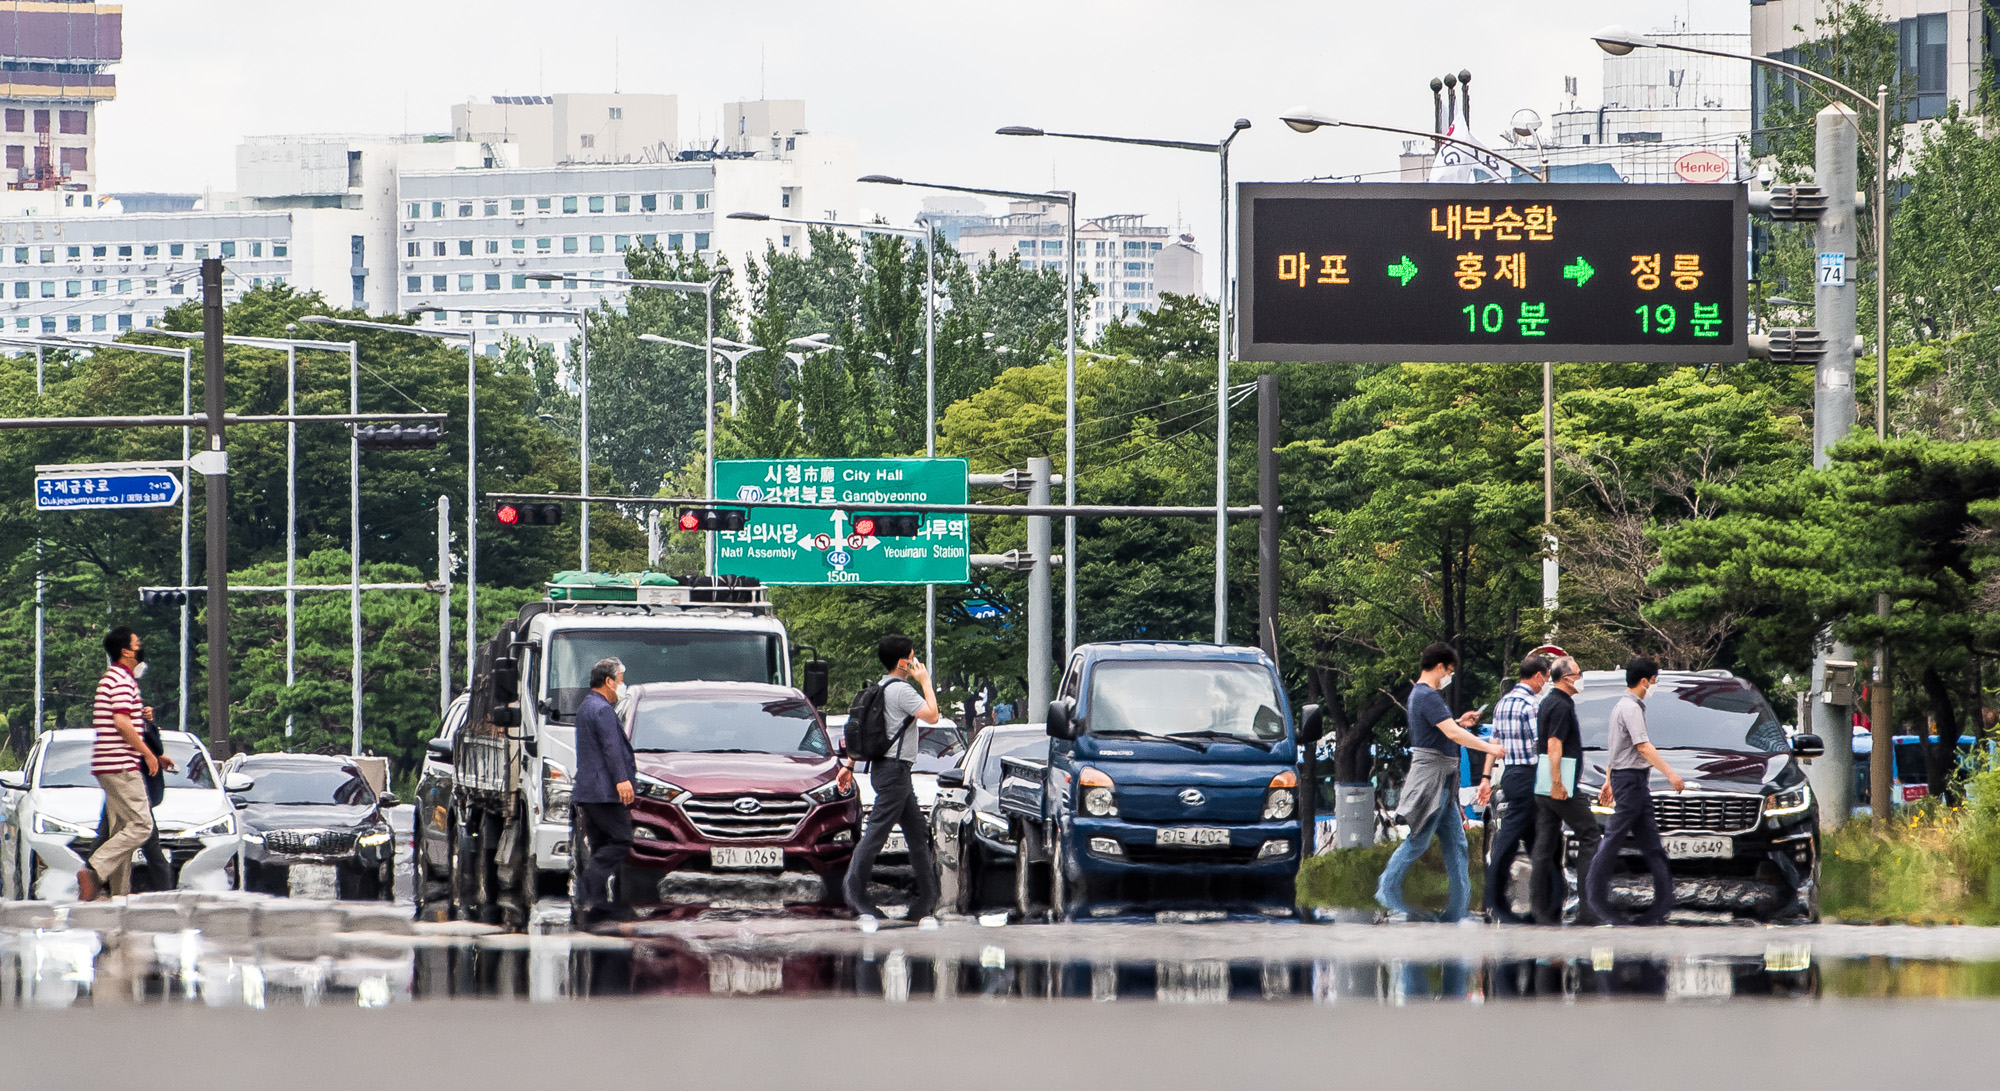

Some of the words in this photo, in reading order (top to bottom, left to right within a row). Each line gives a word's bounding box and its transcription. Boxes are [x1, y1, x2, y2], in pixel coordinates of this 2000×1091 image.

[1680, 161, 1725, 173] Henkel
[1430, 204, 1557, 241] 내부순환
[1278, 252, 1350, 287] 마포
[1454, 252, 1526, 290] 홍제
[1630, 253, 1704, 291] 정릉
[1822, 266, 1842, 282] 74
[1462, 303, 1504, 333] 10
[1517, 302, 1550, 337] 분
[1635, 304, 1676, 334] 19
[1690, 302, 1723, 337] 분
[842, 469, 870, 482] City
[876, 469, 903, 480] Hall
[743, 489, 759, 502] 70
[763, 485, 838, 504] 강변북로
[842, 490, 927, 503] Gangbyeonno
[747, 547, 797, 560] Assembly
[830, 553, 846, 563] 46
[884, 546, 927, 558] Yeouinaru
[933, 545, 964, 558] Station
[827, 571, 860, 582] 150m
[744, 849, 777, 864] 0269
